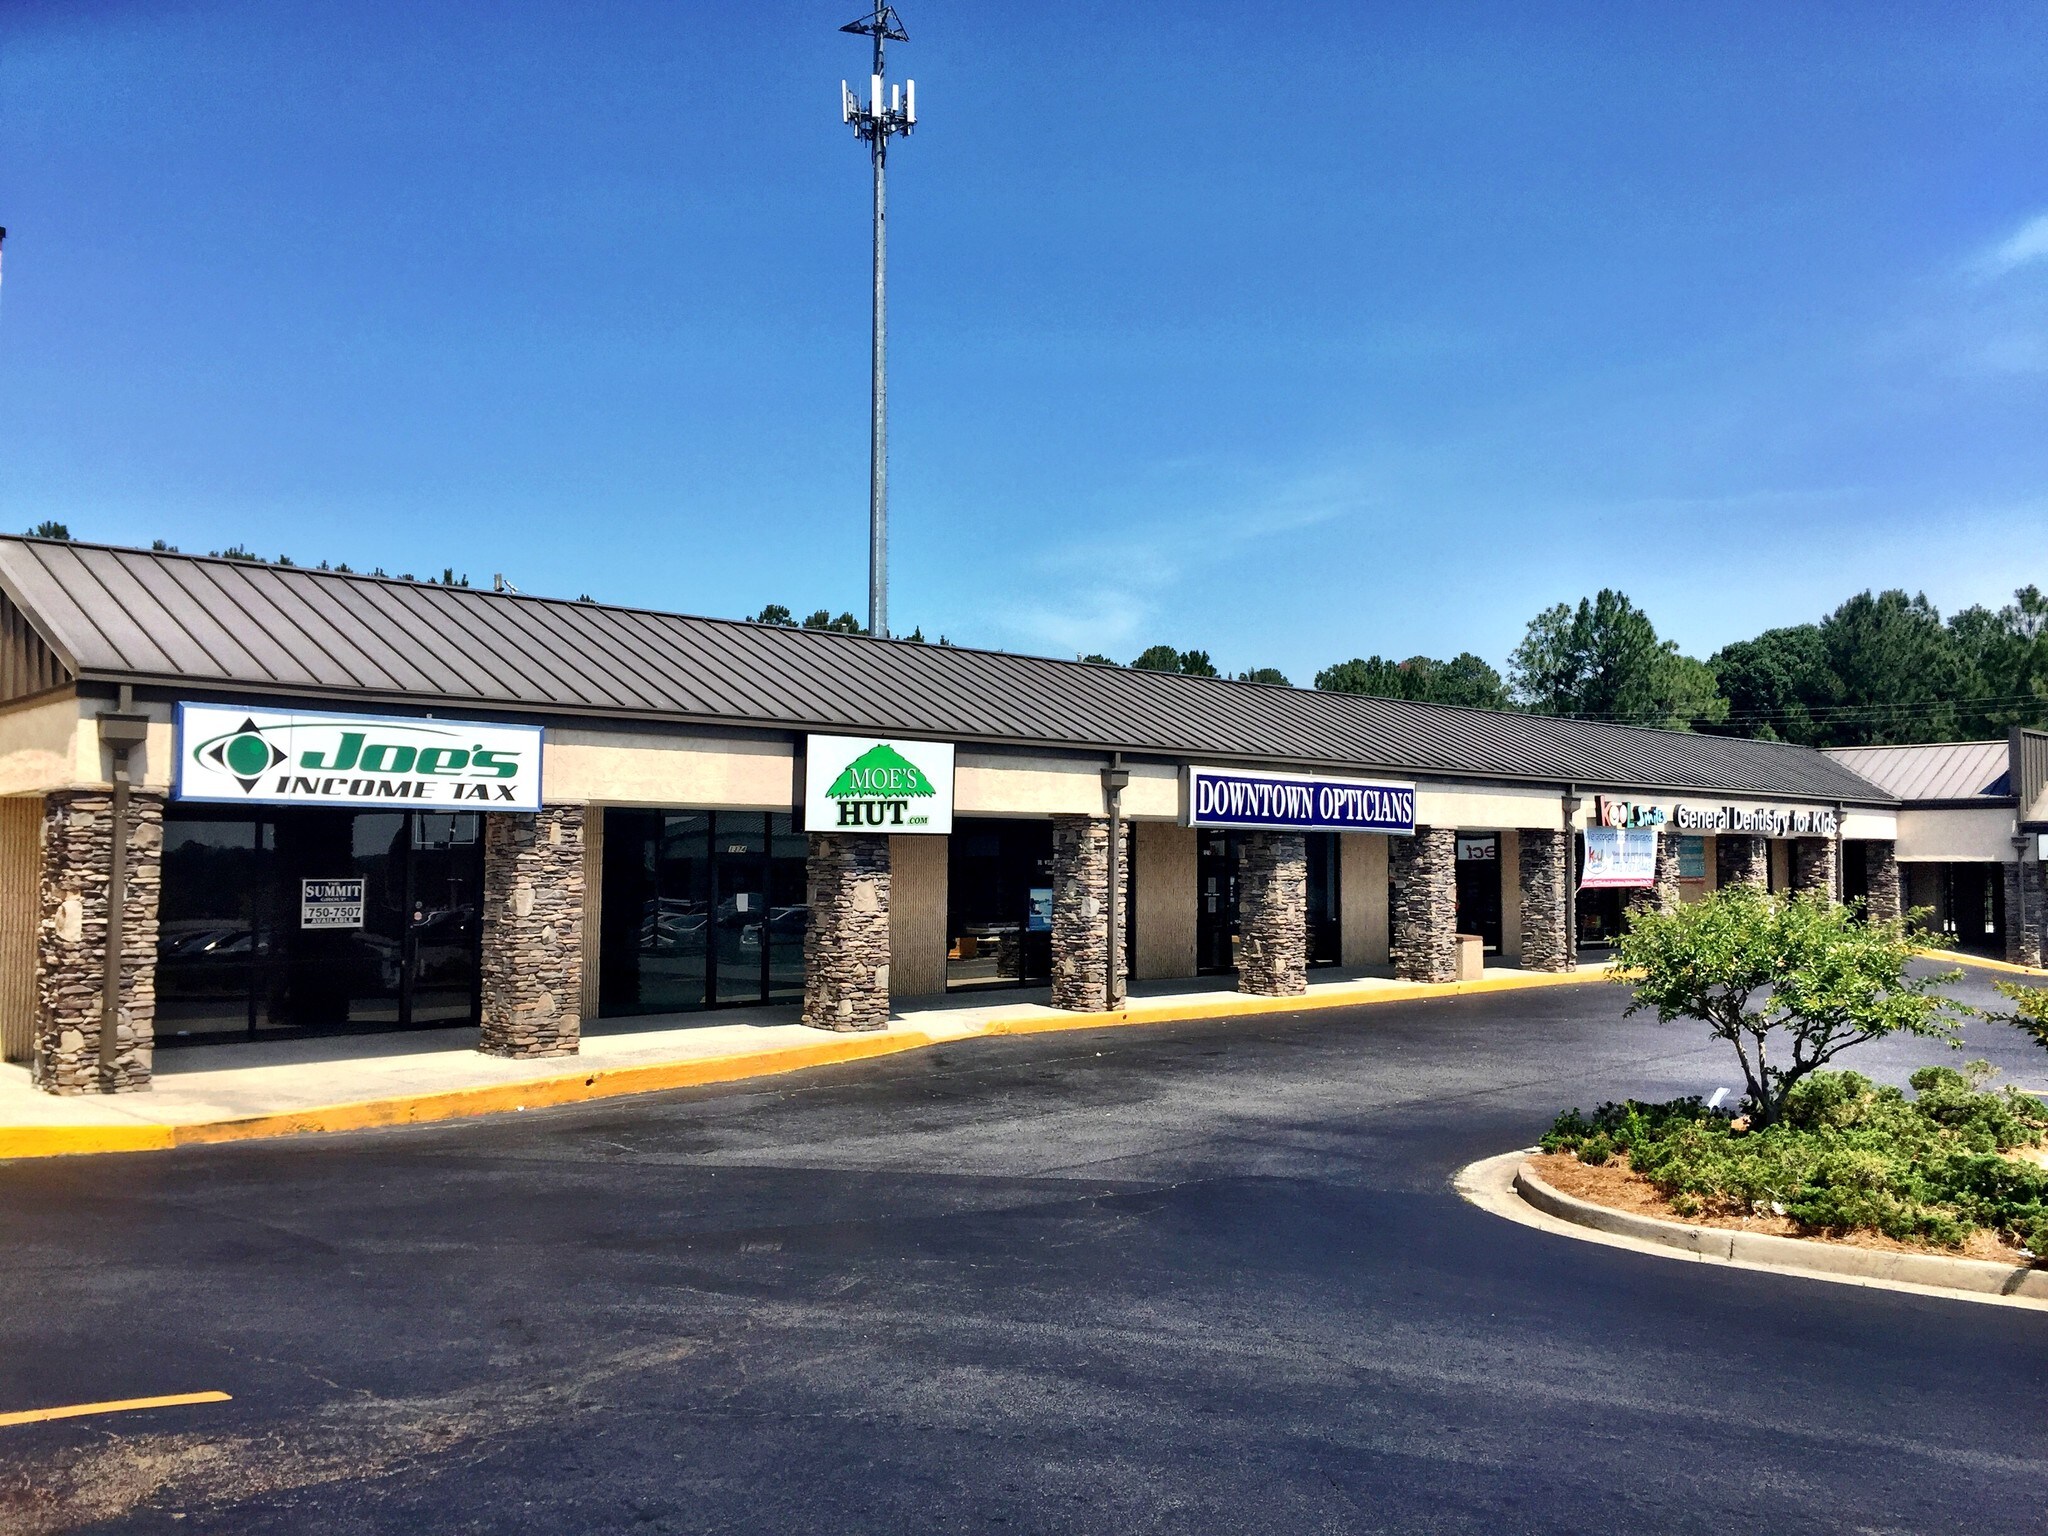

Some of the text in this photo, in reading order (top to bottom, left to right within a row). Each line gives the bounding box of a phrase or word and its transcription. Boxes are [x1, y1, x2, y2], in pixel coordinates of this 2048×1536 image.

[300, 732, 522, 778] Joe's
[275, 776, 519, 801] INCOME TAX
[849, 767, 917, 790] MOE'S
[836, 799, 928, 826] HUT .COM
[1198, 780, 1414, 823] DOWNTOWN OPTICIANS
[1677, 804, 1838, 836] General Dentistry for Kids
[305, 885, 361, 898] SUMMIT
[308, 907, 361, 917] 750-7507
